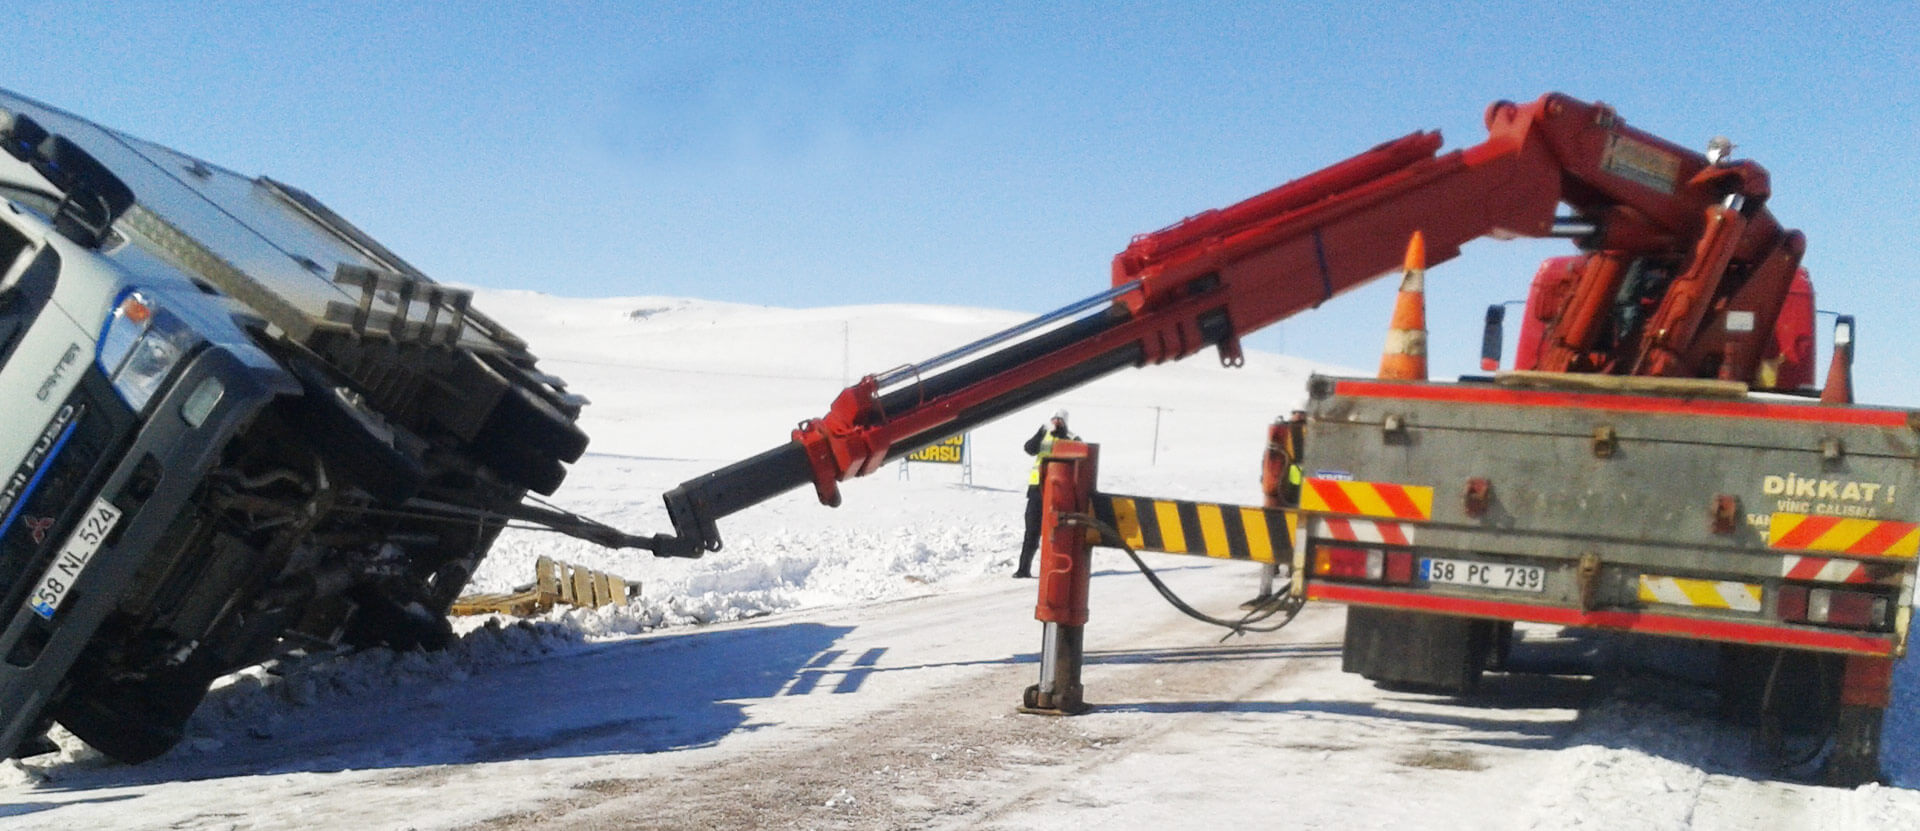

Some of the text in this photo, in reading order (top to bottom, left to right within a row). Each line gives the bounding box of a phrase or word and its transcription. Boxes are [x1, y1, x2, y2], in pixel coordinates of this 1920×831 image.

[27, 404, 74, 469] FUSO
[38, 507, 115, 605] 58 NL 524
[1432, 561, 1540, 588] 58 PC 739
